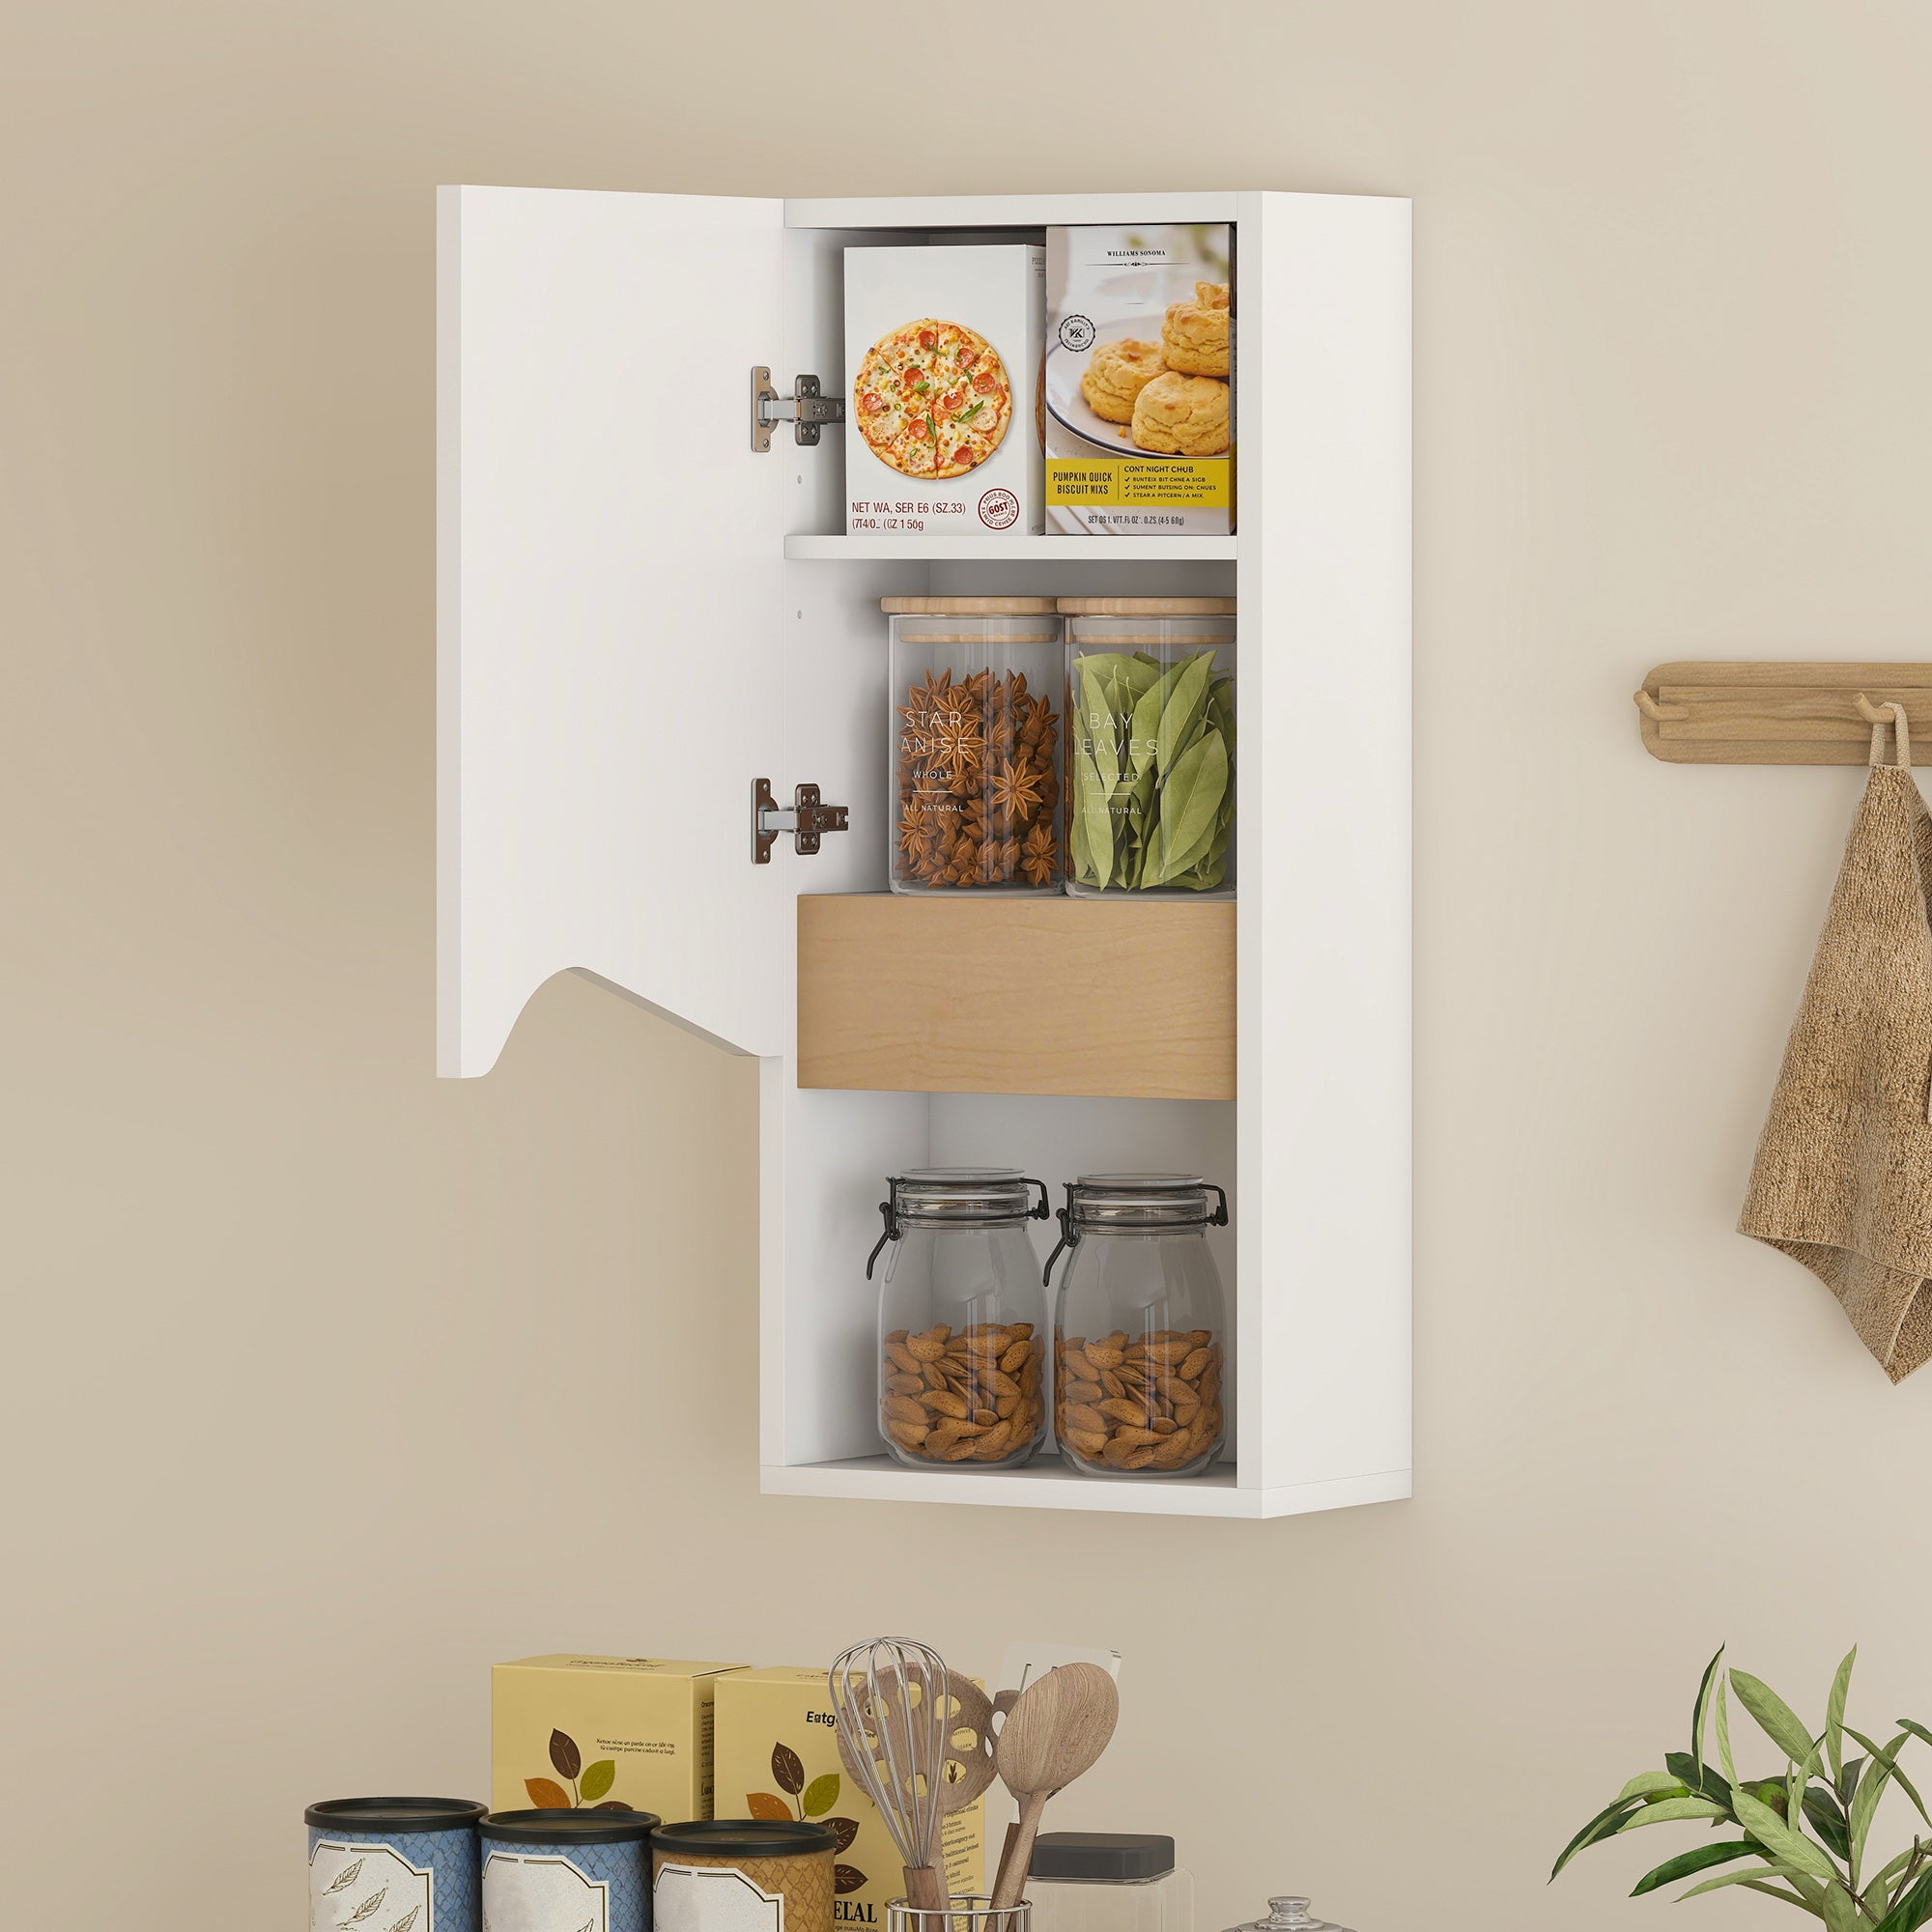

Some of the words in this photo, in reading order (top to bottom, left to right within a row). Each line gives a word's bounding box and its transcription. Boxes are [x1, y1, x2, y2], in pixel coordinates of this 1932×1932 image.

[1053, 471, 1087, 482] PUMPKIN
[1089, 471, 1113, 482] QUICK
[1057, 484, 1089, 495] BISCUIT
[852, 501, 869, 513] NET
[873, 502, 893, 515] WA,
[895, 502, 914, 513] SER
[917, 502, 929, 514] E6
[988, 501, 1008, 515] GOST
[906, 711, 962, 727] STAR
[1090, 713, 1133, 729] BAY
[901, 737, 969, 753] ANISE
[1074, 739, 1158, 755] LEAVES
[913, 771, 952, 780] WHOLE
[1083, 773, 1140, 781] SELECTED
